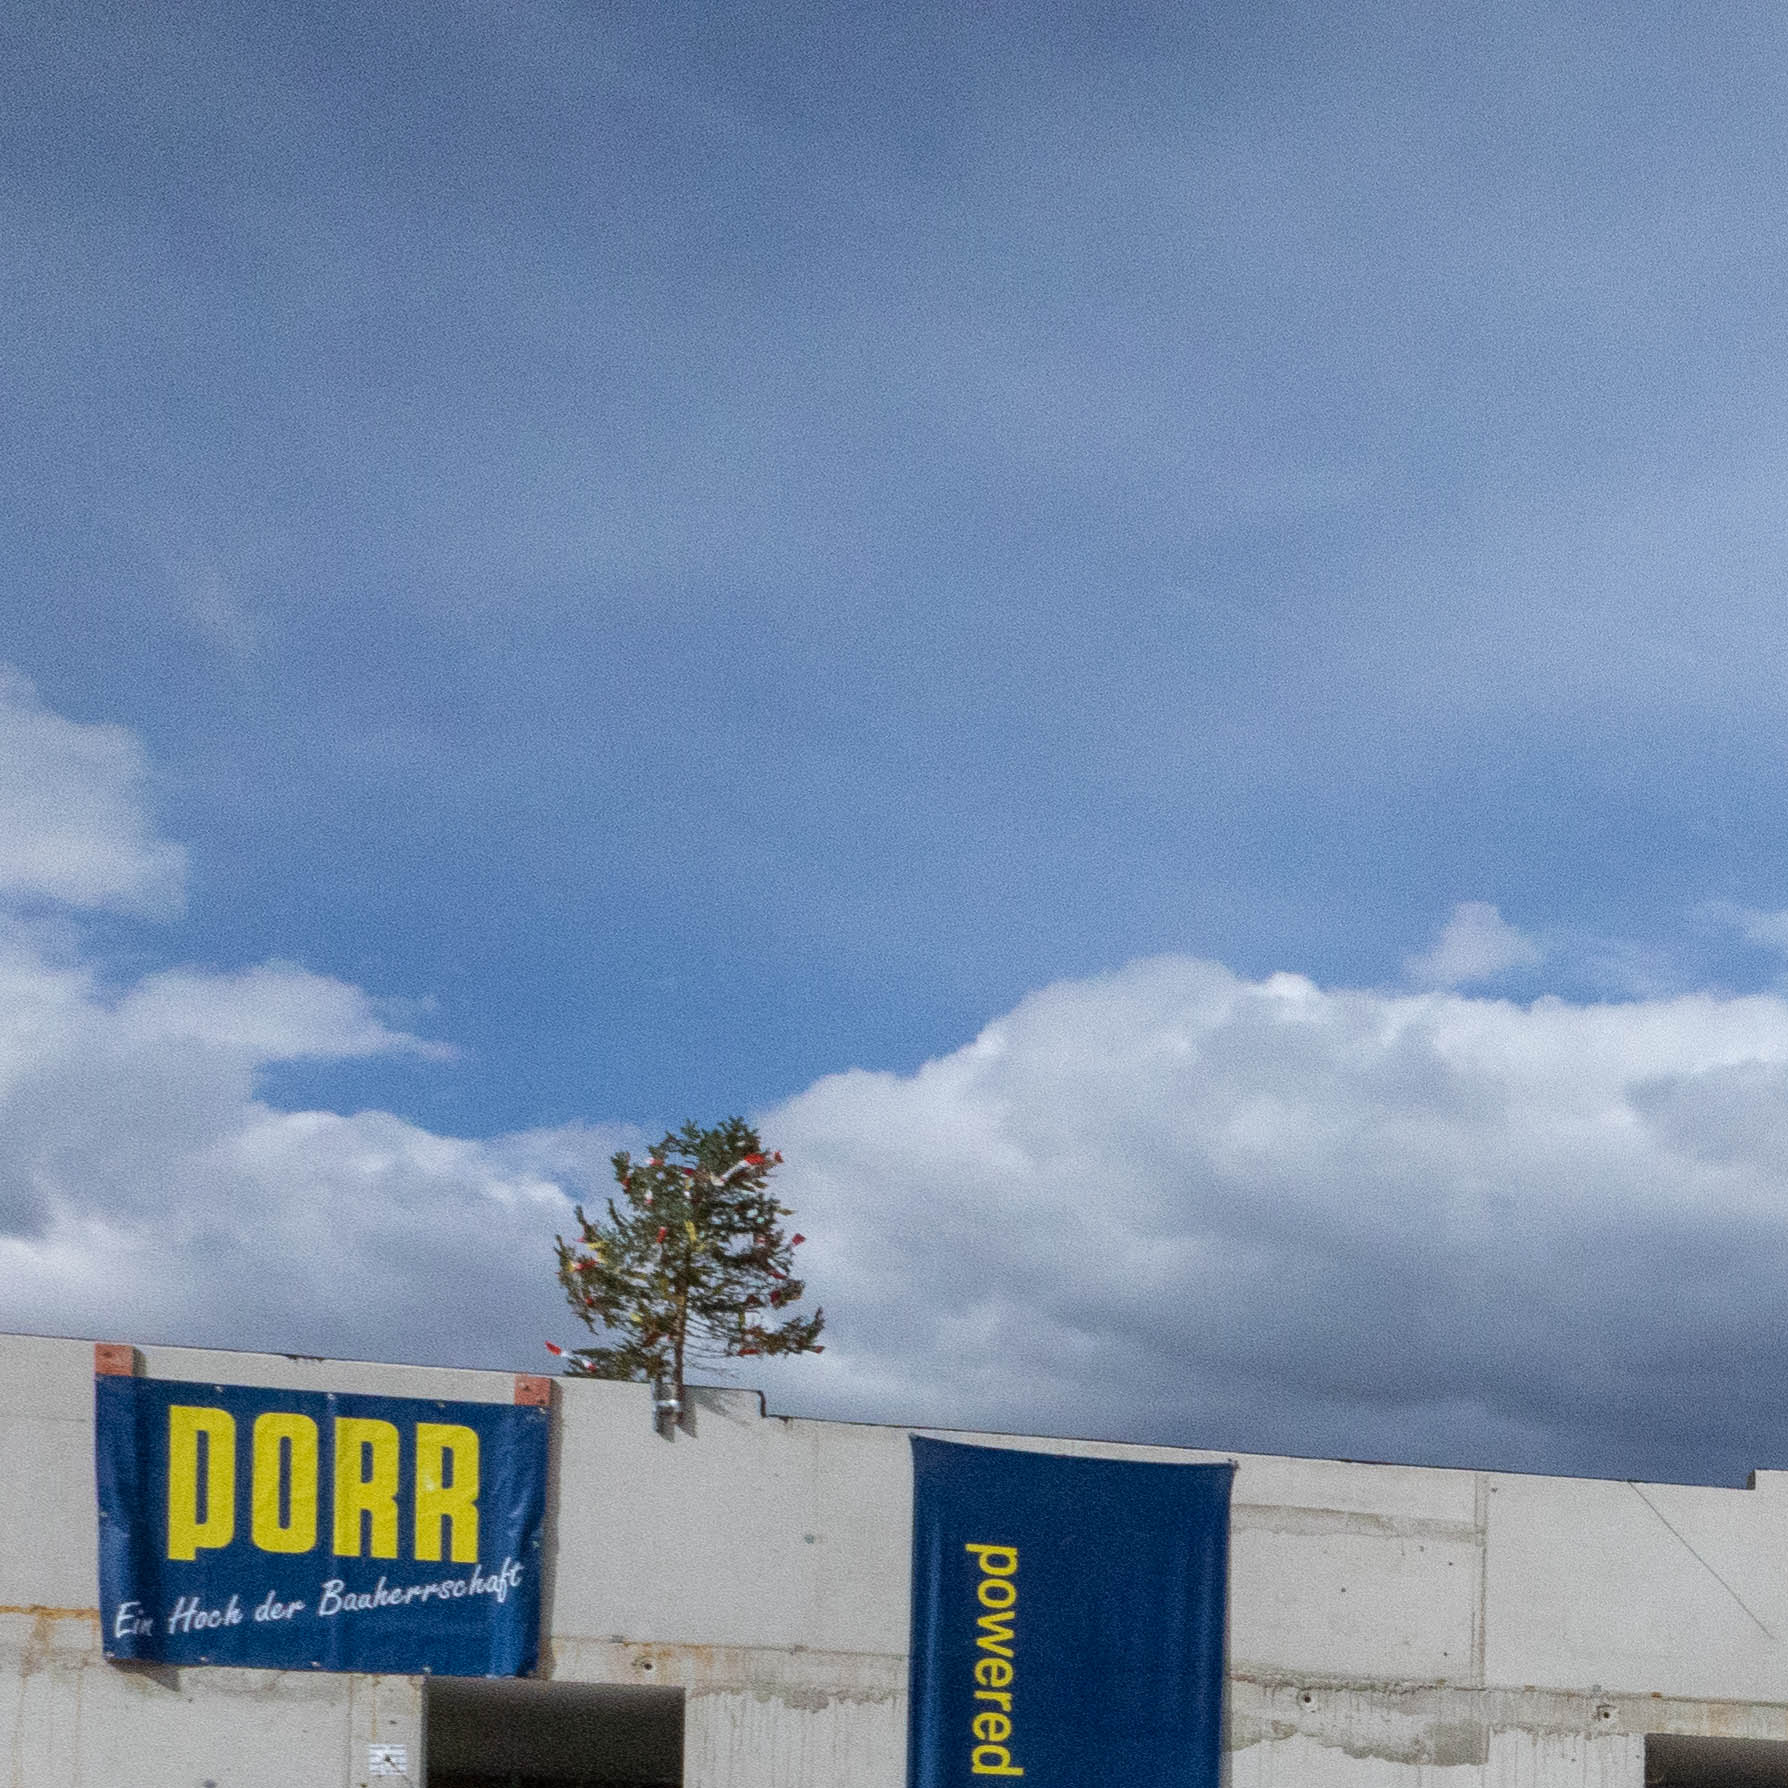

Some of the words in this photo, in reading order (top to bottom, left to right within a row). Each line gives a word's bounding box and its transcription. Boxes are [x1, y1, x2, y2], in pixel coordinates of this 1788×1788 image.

[168, 1405, 480, 1563] PORR
[114, 1600, 153, 1638] Ein
[168, 1593, 242, 1635] Hoch
[254, 1590, 306, 1622] der
[318, 1557, 525, 1617] Bauherrschaft
[965, 1543, 1024, 1776] powered
